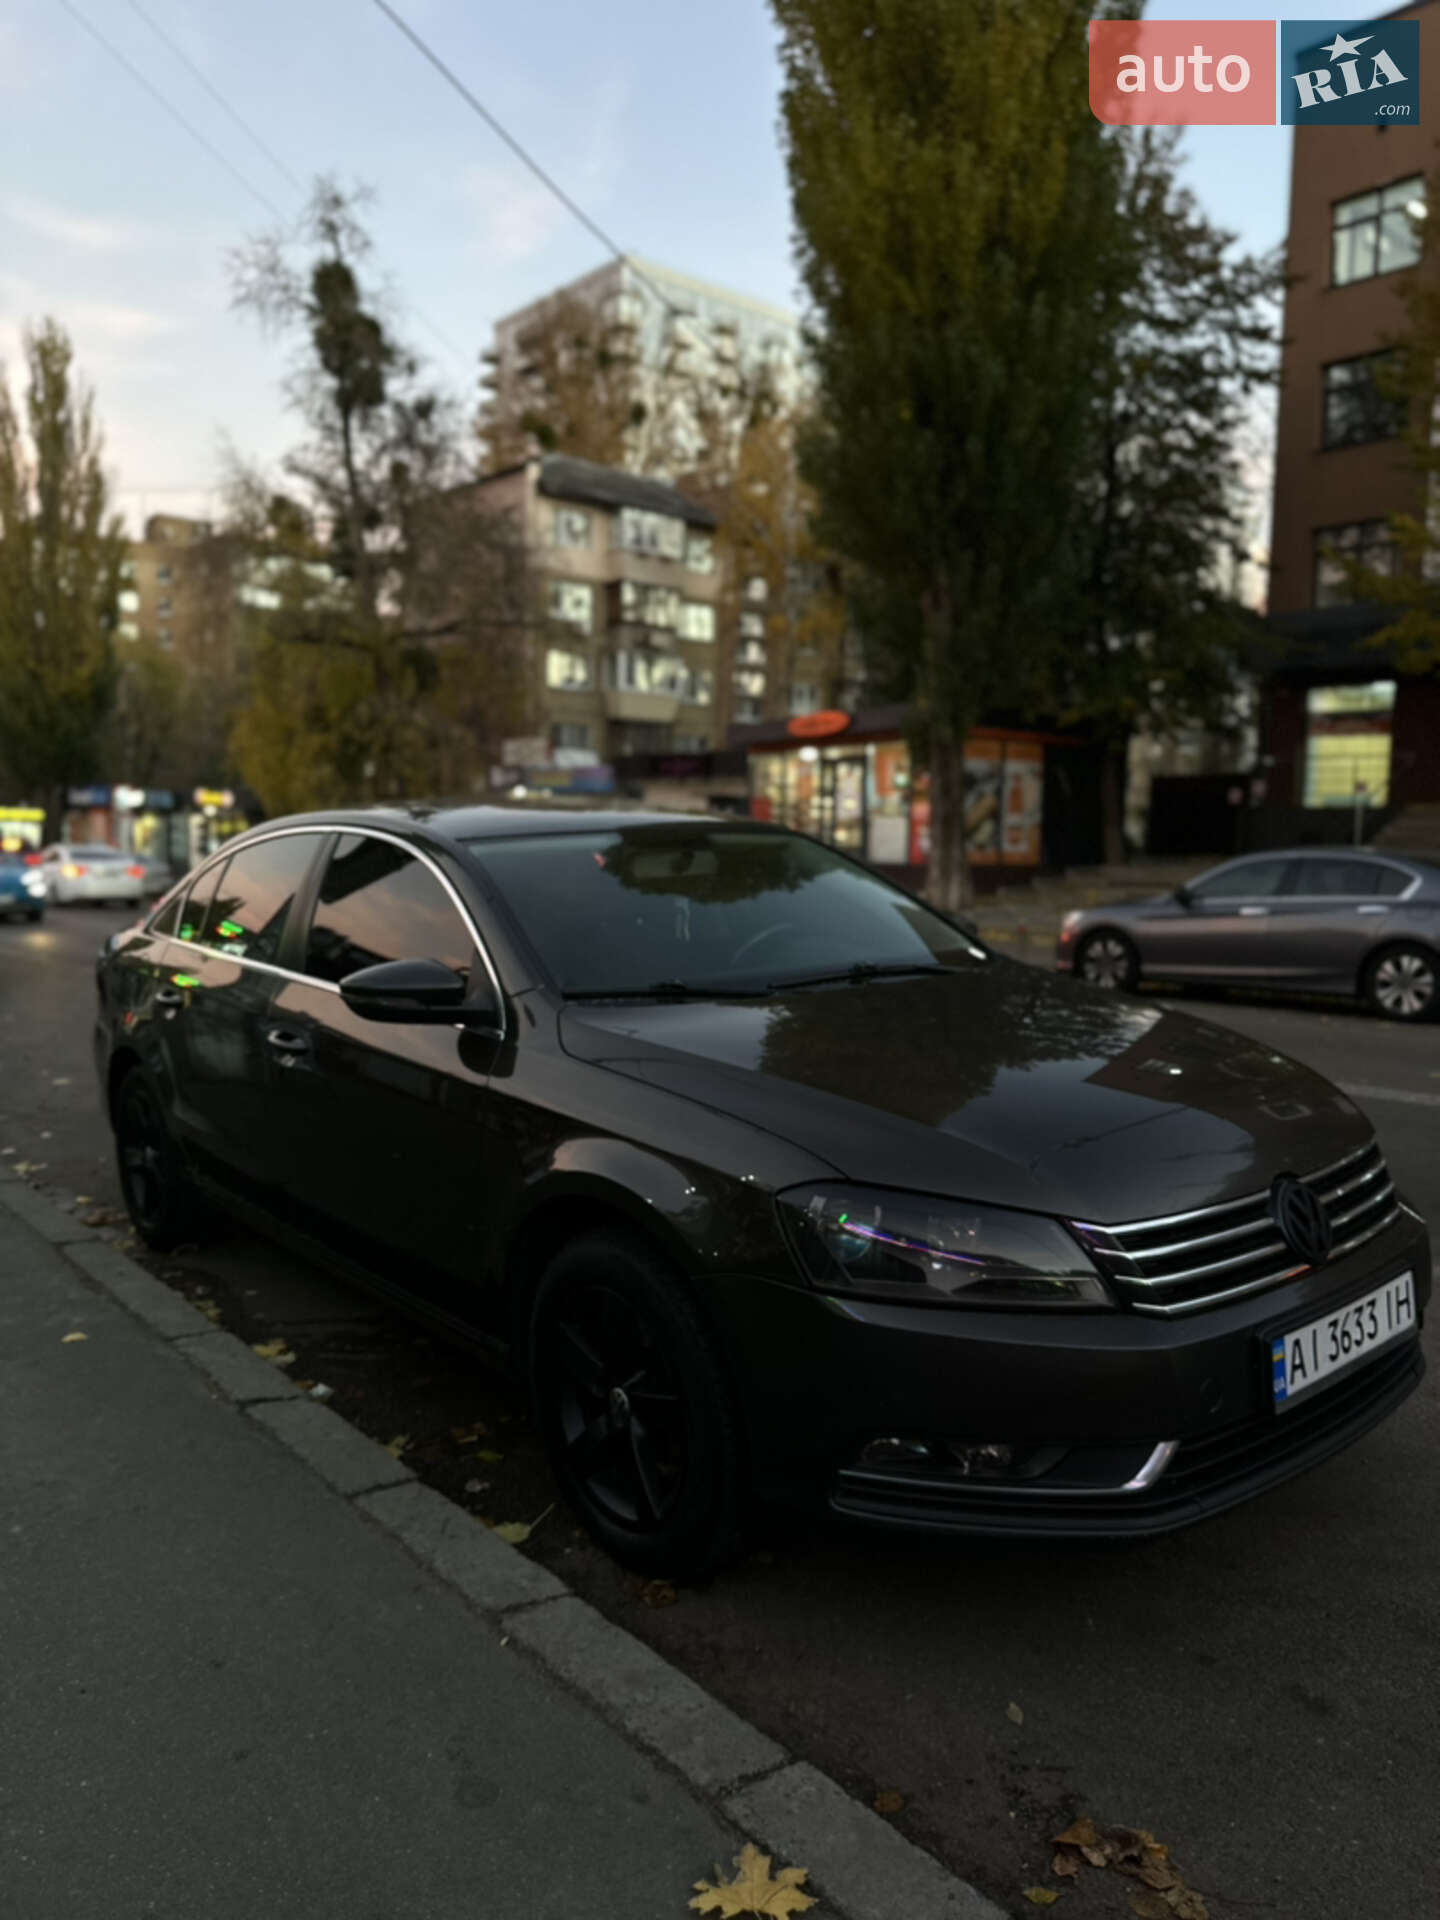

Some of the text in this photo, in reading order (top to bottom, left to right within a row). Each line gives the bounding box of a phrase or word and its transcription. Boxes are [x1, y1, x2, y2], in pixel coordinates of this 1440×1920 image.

[1289, 1279, 1412, 1385] AI 3633 IH
